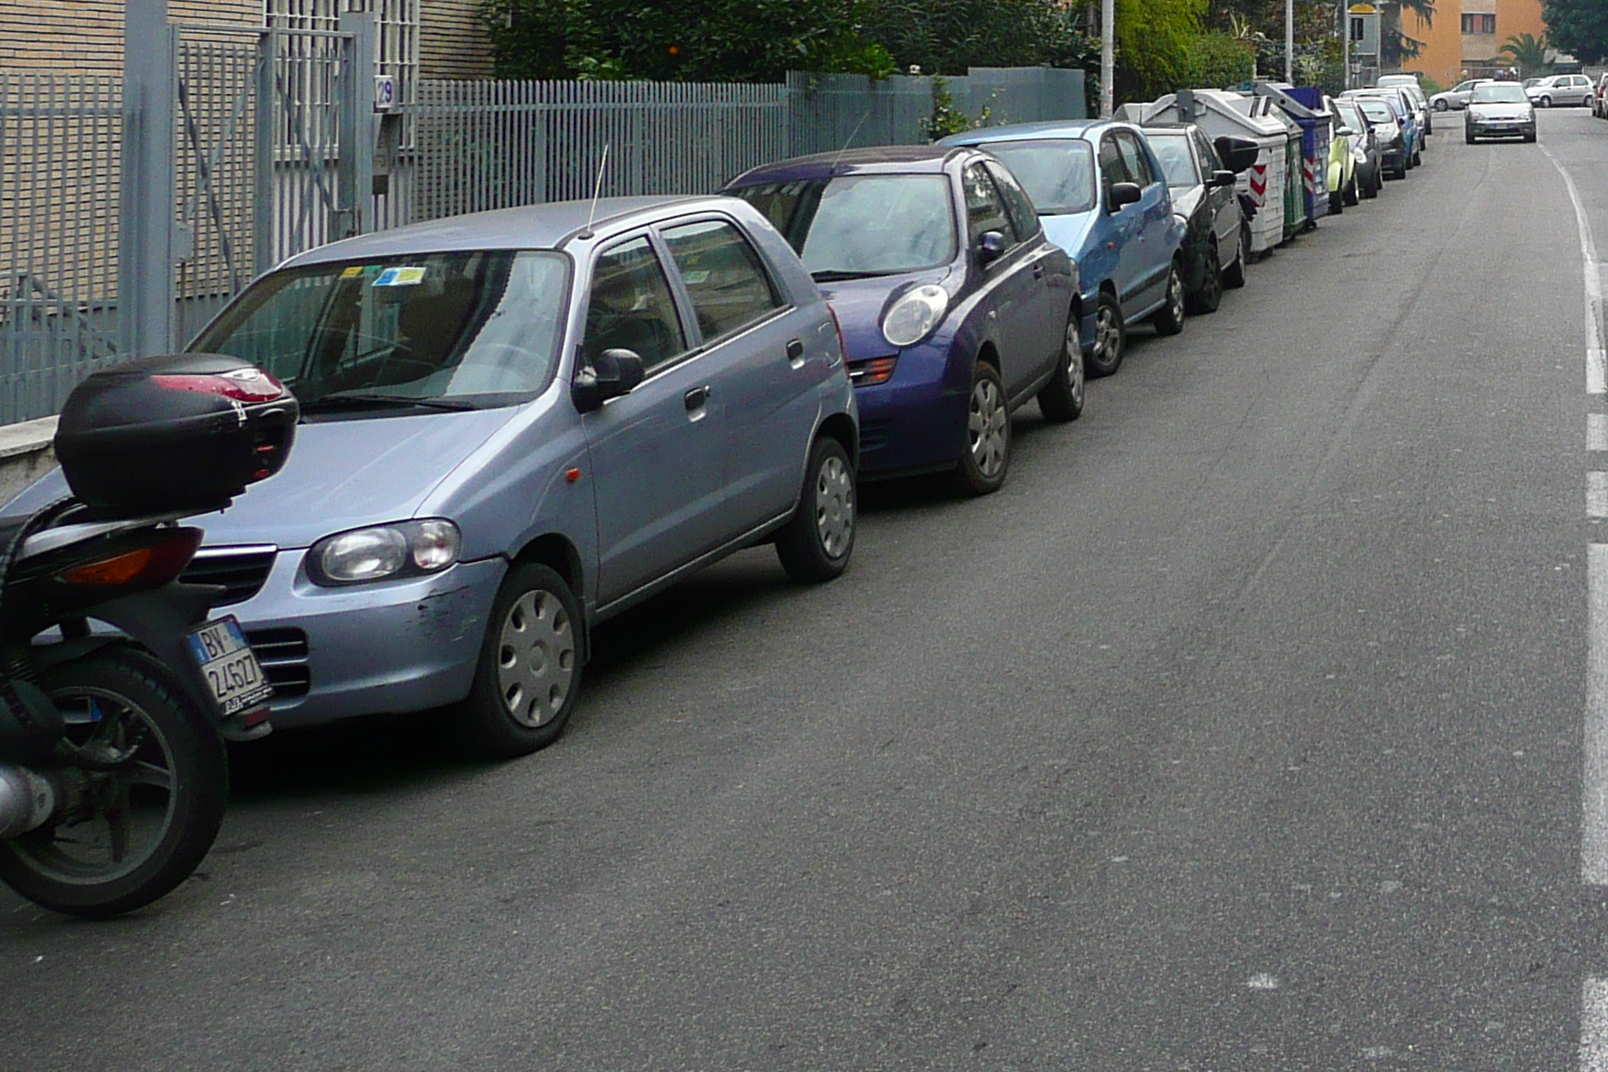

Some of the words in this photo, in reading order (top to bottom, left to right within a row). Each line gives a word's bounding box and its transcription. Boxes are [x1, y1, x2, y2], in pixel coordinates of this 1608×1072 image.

[378, 80, 393, 104] 29
[200, 627, 227, 659] BV
[208, 654, 258, 698] 24627
